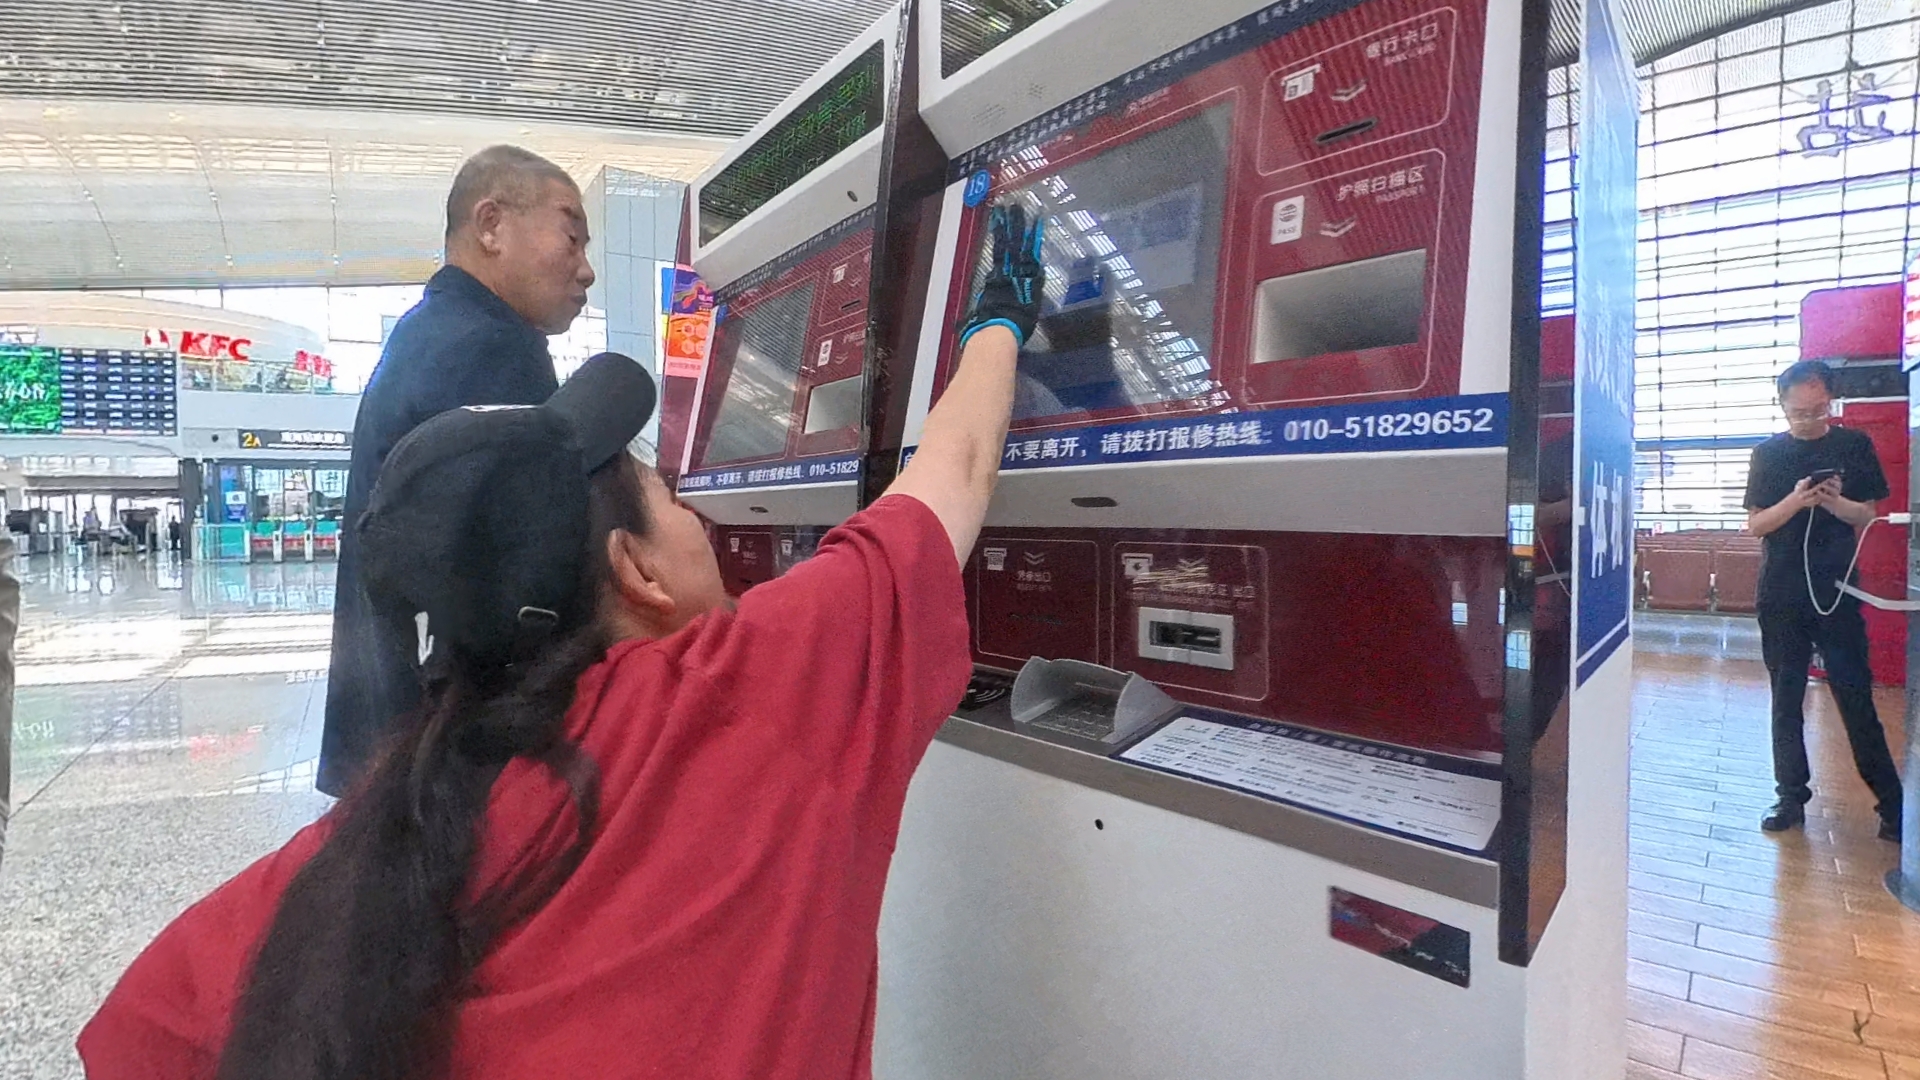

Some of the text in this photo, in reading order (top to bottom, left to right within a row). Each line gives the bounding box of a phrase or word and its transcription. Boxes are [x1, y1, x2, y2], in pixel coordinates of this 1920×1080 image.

[968, 176, 987, 197] 18
[180, 331, 251, 361] KFC
[1284, 407, 1494, 442] 010-51829652
